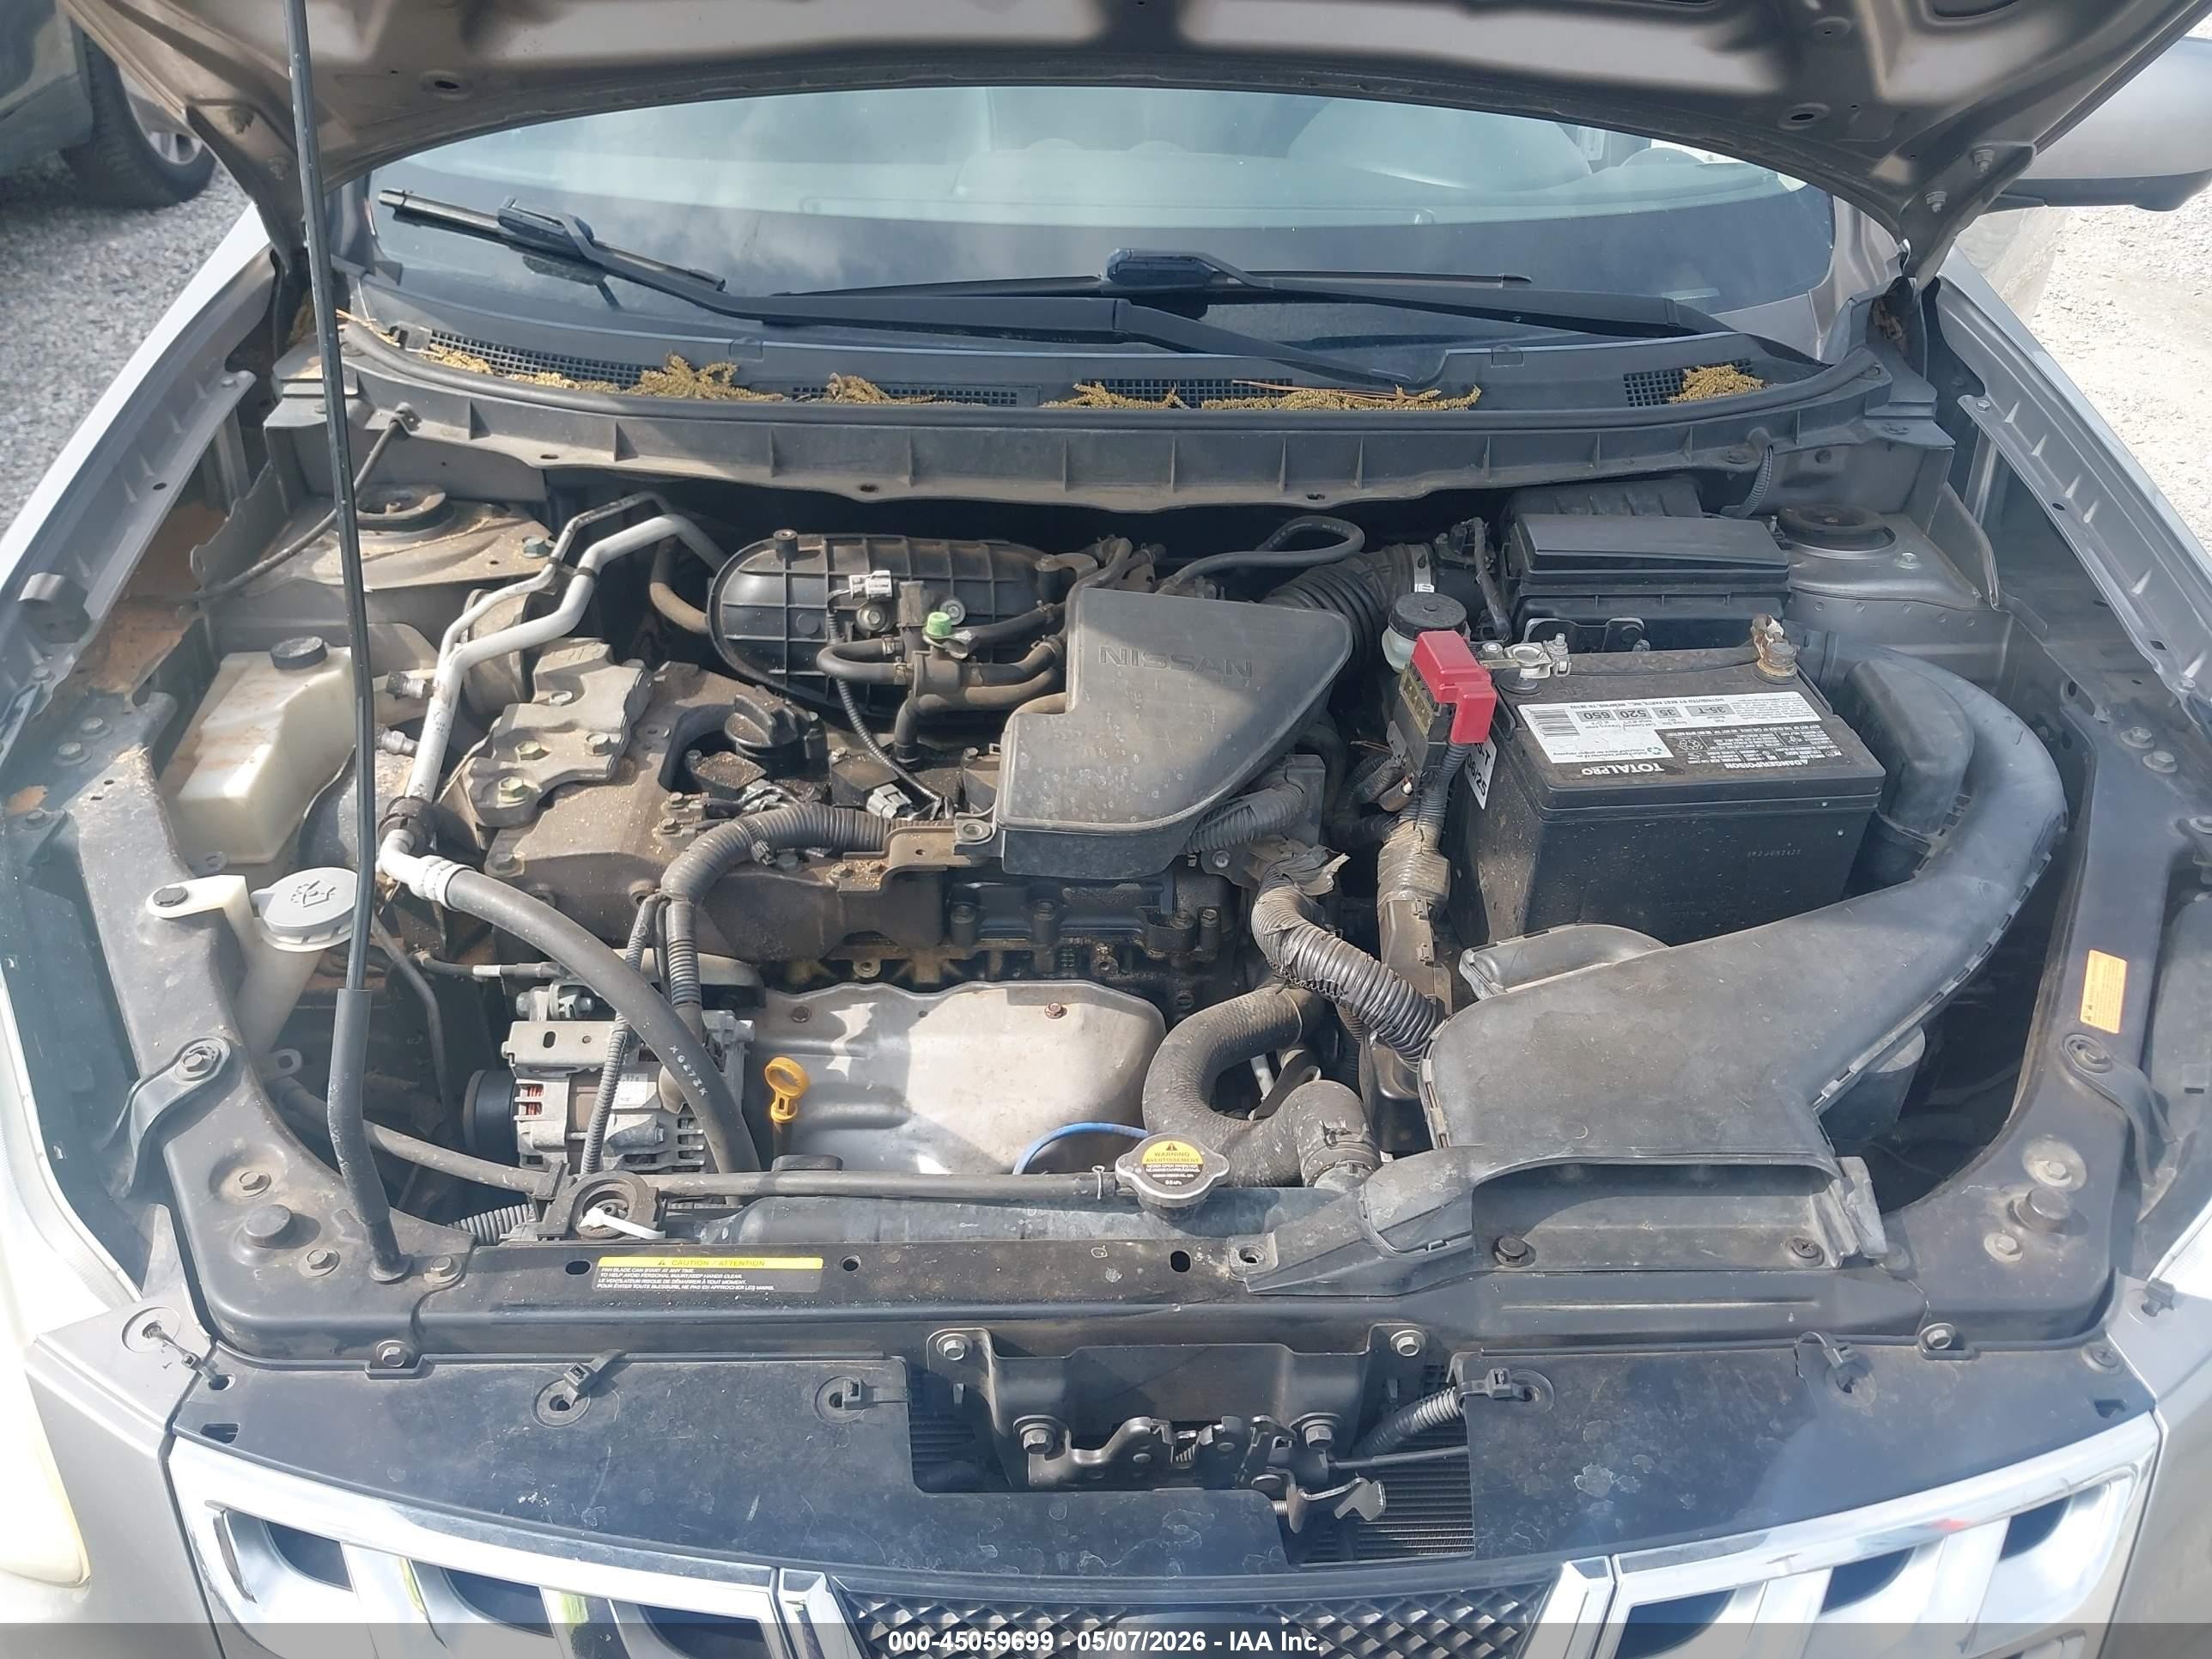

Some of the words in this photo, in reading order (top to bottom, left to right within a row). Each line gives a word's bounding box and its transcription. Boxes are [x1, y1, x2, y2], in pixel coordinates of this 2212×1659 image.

[1098, 645, 1253, 678] NISSAN
[1583, 710, 1610, 719] 650
[1620, 709, 1647, 719] 520
[1581, 762, 1664, 775] TOTALPRO
